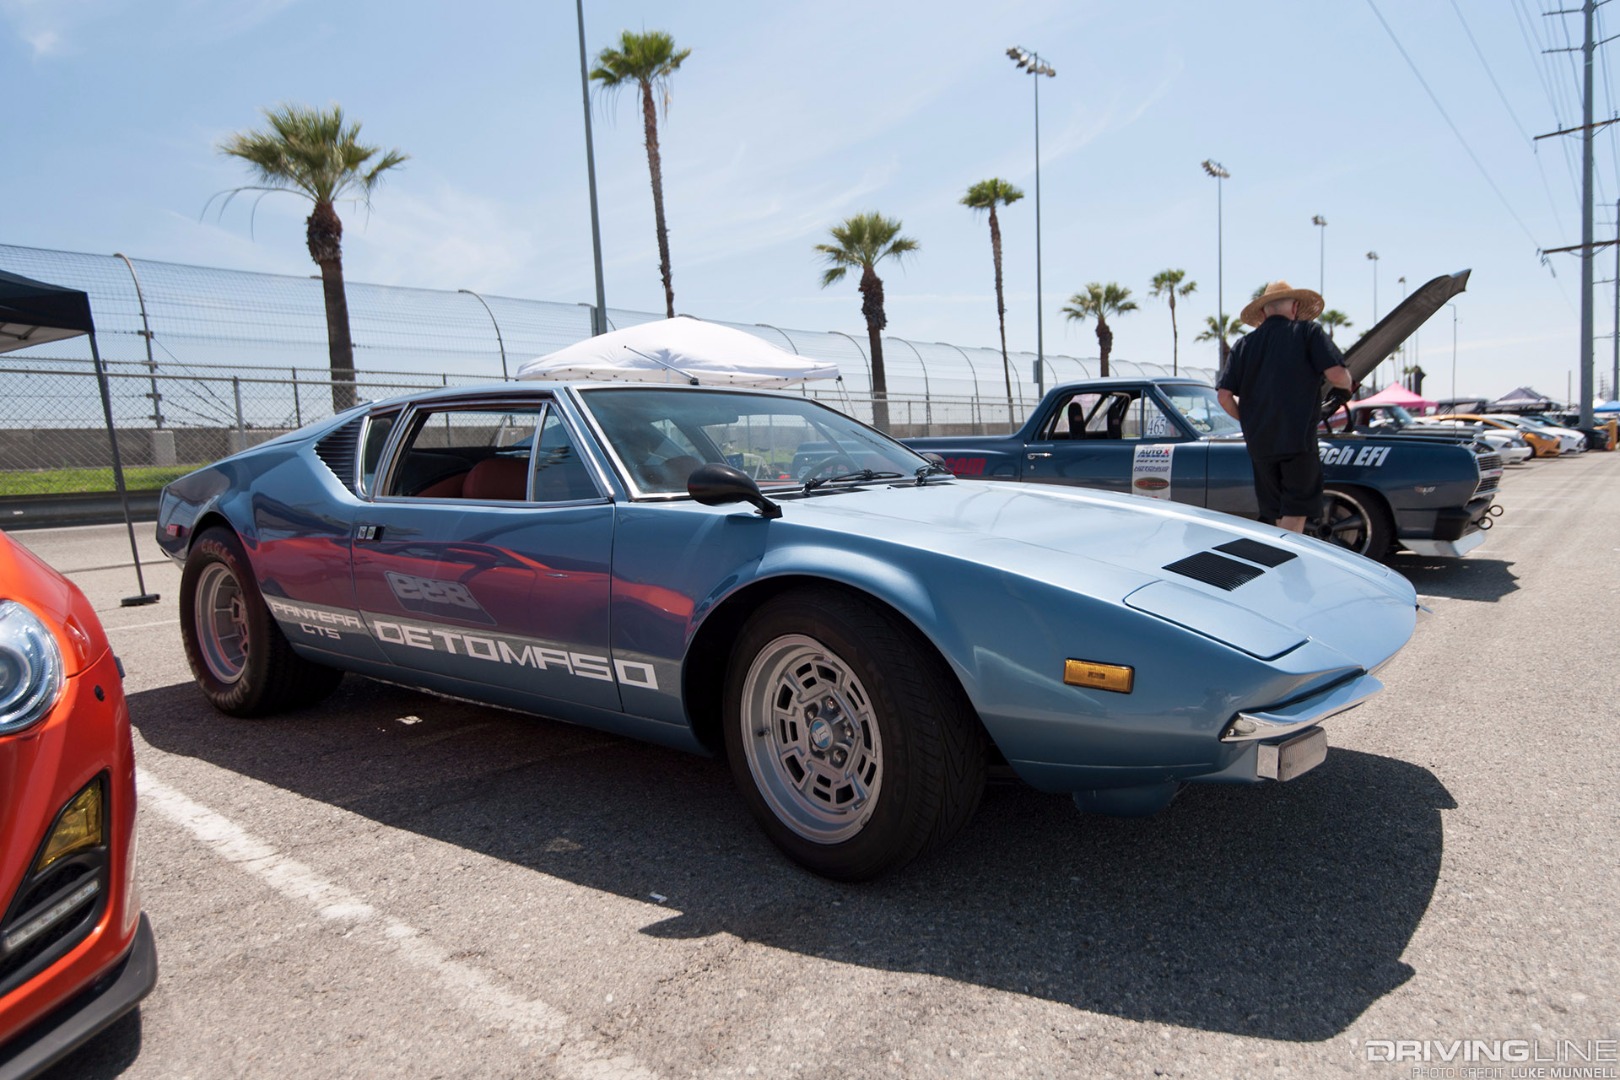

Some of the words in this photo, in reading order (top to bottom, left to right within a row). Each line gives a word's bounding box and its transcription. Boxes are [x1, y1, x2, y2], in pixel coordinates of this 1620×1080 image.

[1147, 418, 1165, 434] 465
[1353, 446, 1392, 467] EFI
[269, 602, 362, 628] PANTERA
